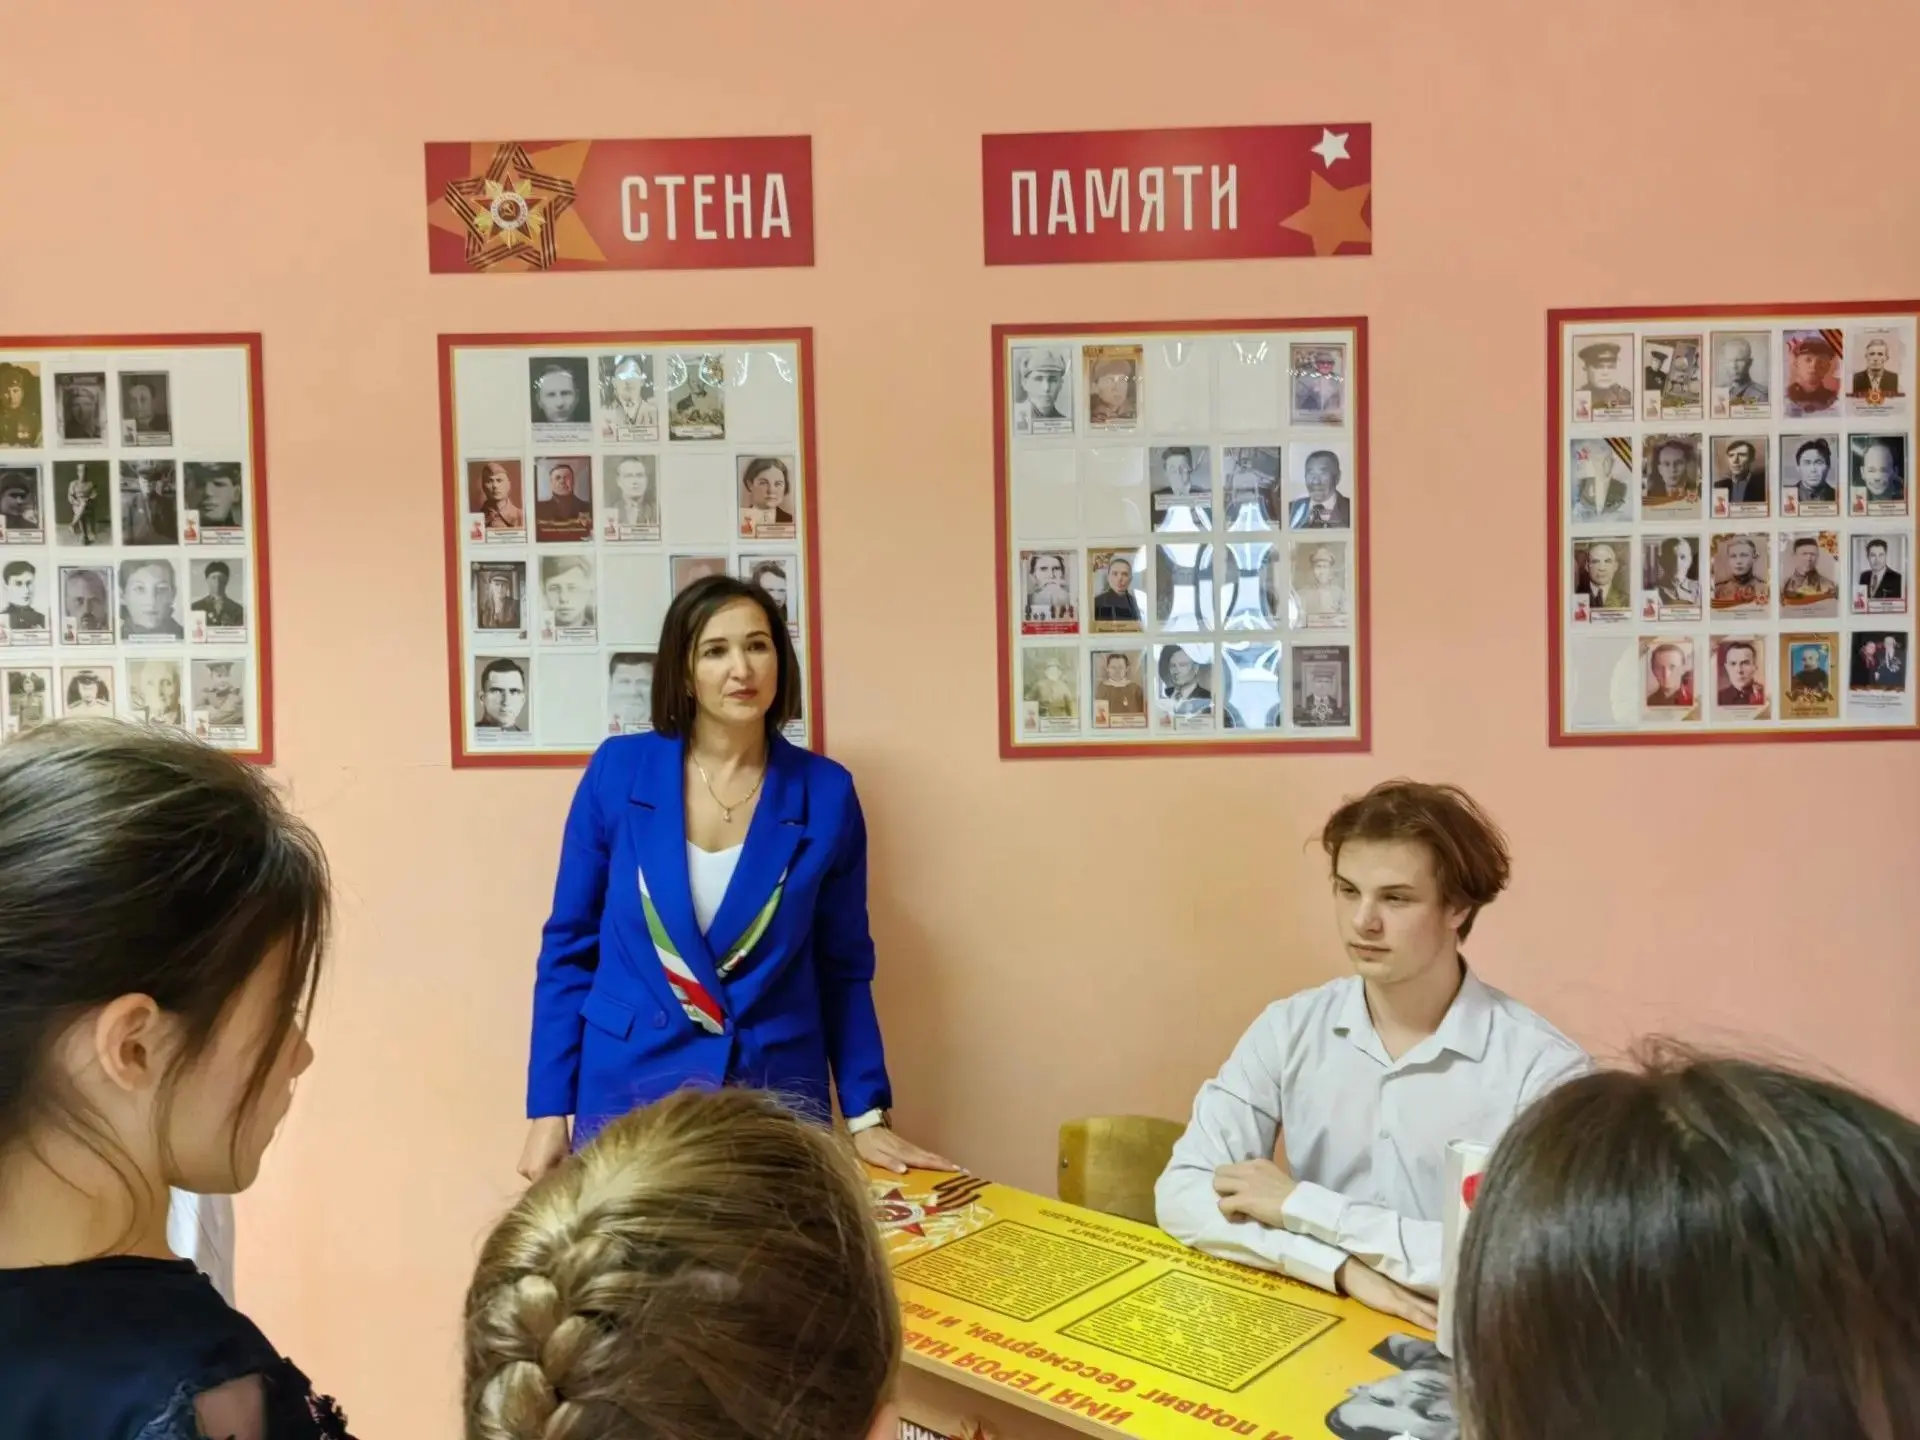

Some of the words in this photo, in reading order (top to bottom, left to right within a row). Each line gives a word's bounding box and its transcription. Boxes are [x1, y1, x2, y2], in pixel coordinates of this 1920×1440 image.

[621, 172, 791, 242] СТЕНА
[1011, 164, 1237, 236] ПАМЯТИ
[936, 1316, 963, 1328] и
[952, 1352, 1056, 1395] ГЕРОЯ
[964, 1322, 1138, 1393] бессмертен,
[1049, 1388, 1135, 1426] ИМЯ
[1136, 1388, 1259, 1436] подвиг
